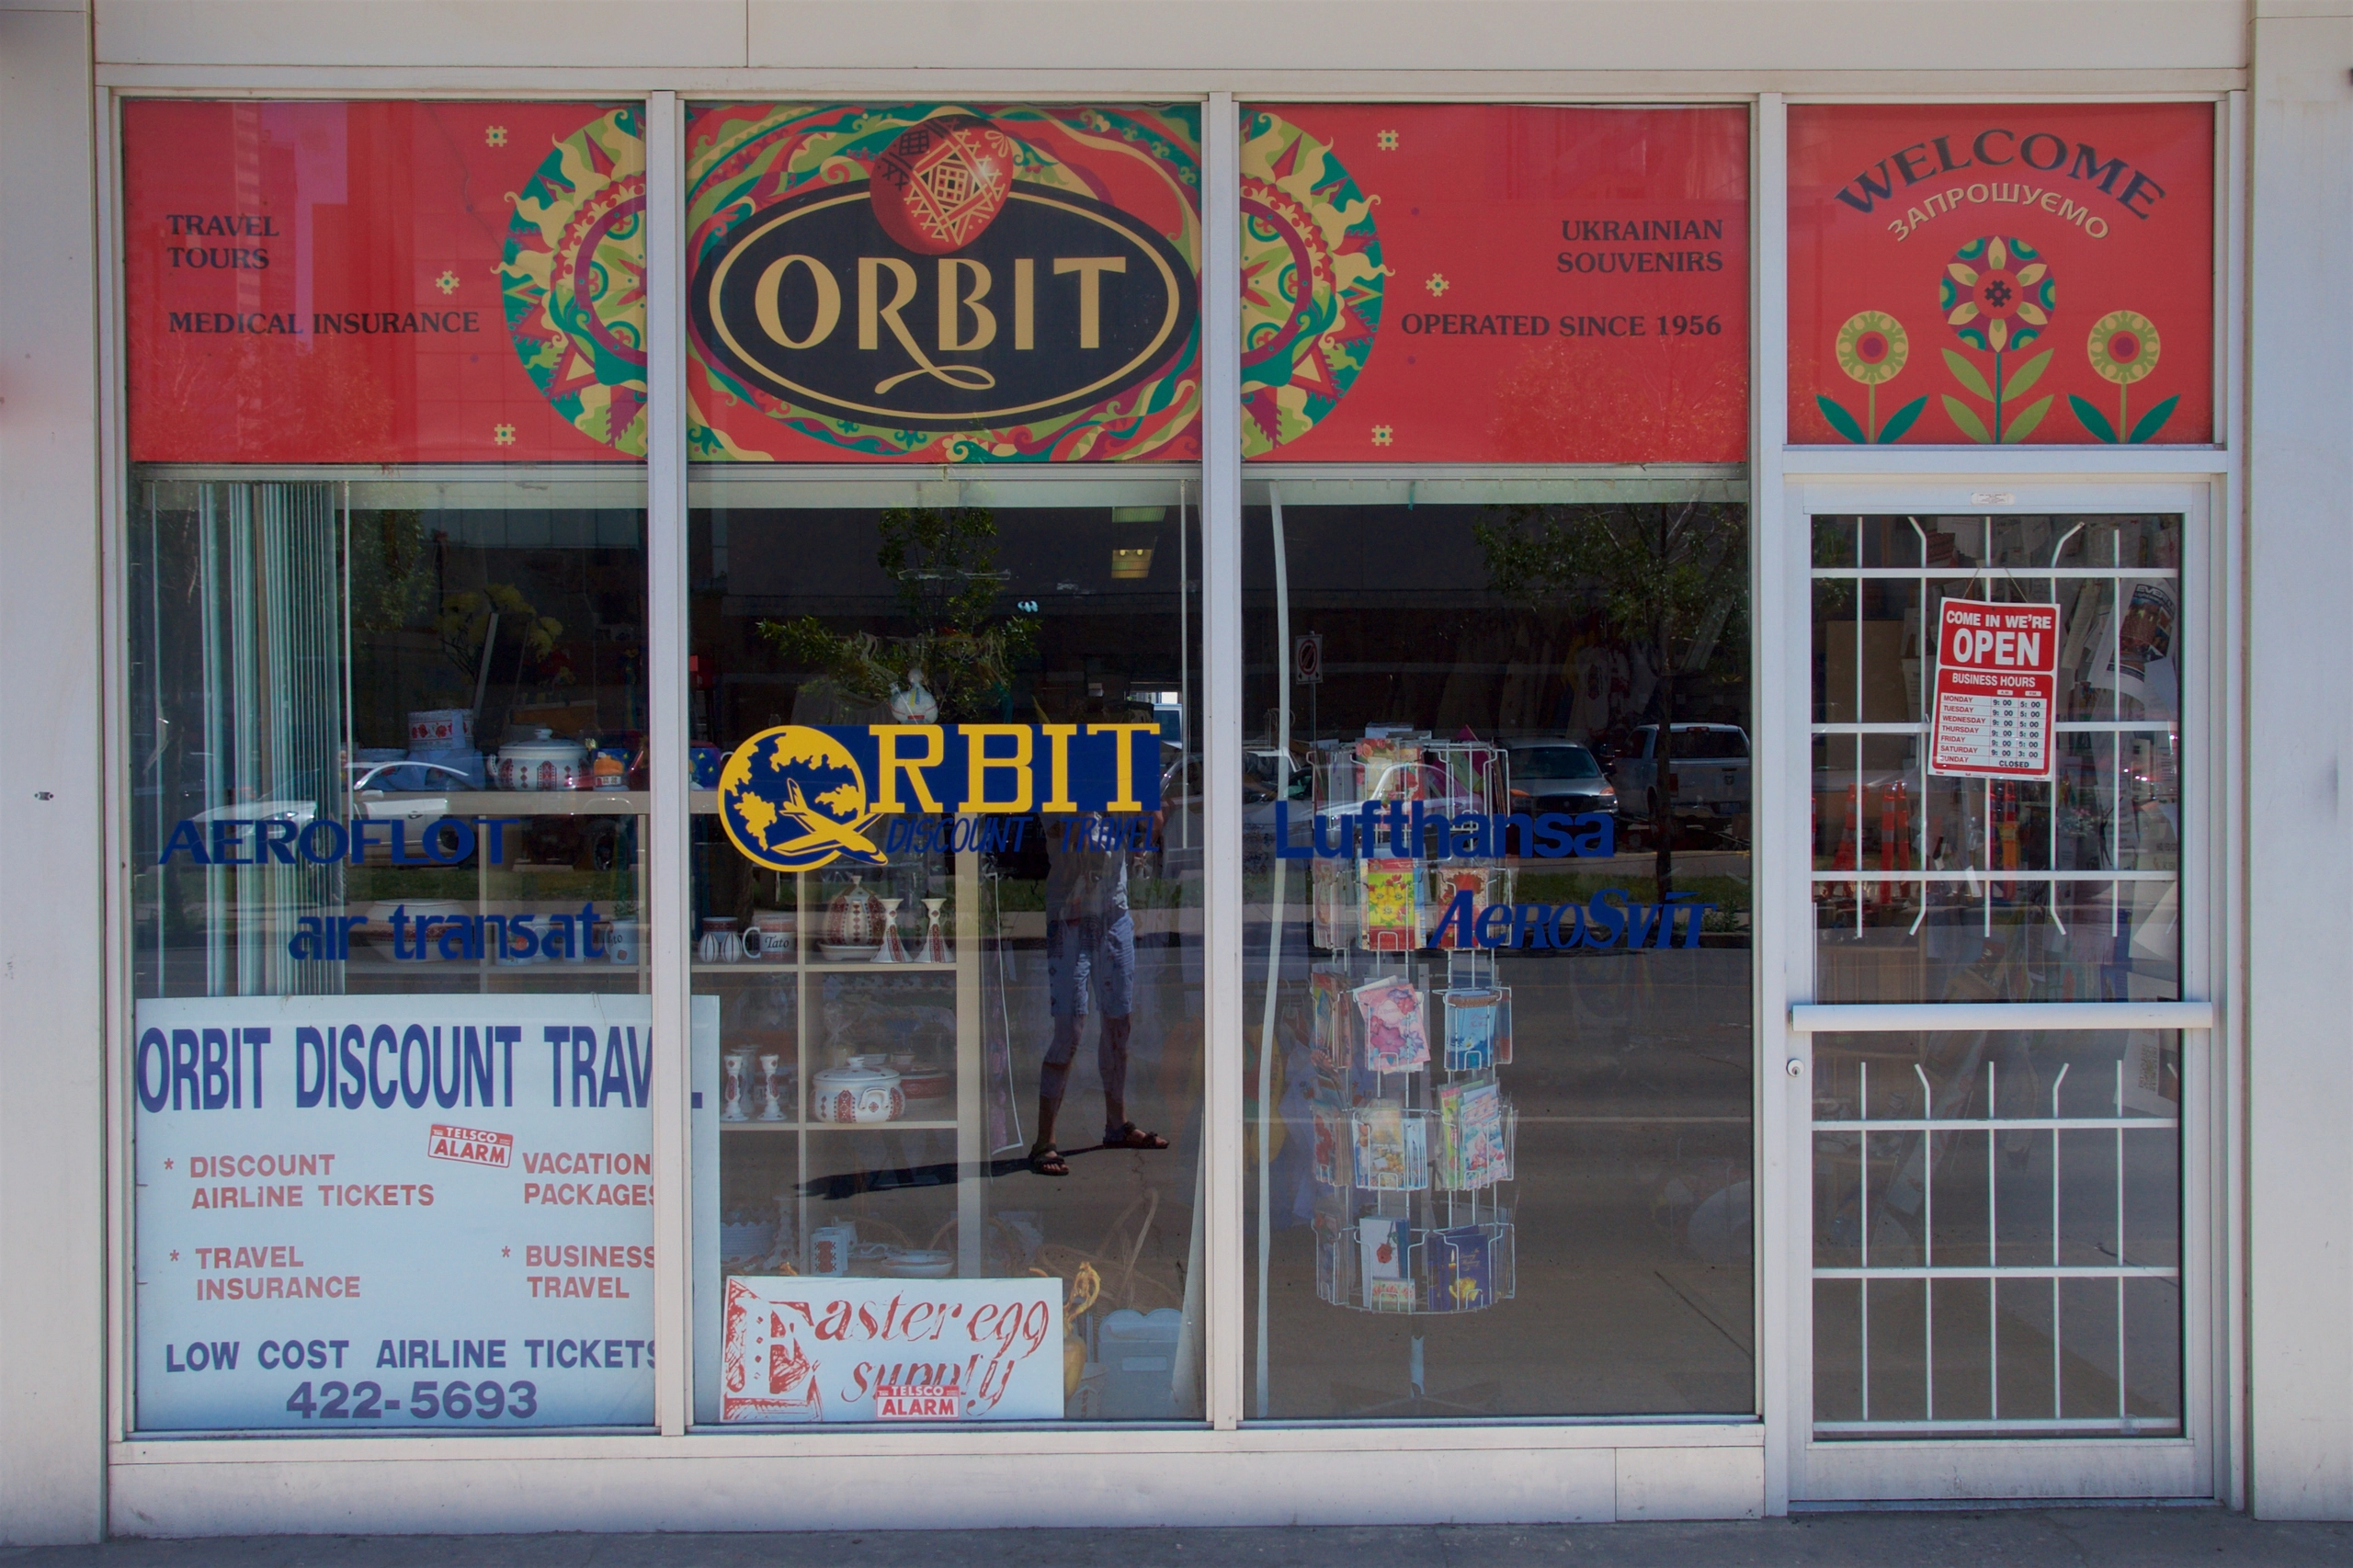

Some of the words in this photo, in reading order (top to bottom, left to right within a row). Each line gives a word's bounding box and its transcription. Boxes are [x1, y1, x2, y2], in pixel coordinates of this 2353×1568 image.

[1833, 128, 2166, 221] WELCOME
[1887, 182, 2110, 242] ЗАПРОШУЄМО
[166, 213, 279, 237] TRAVEL
[1562, 219, 1724, 243] UKRAINIAN
[166, 246, 269, 269] TOURS
[1556, 251, 1724, 274] SOUVENIRS
[167, 311, 303, 335] MEDICAL
[313, 311, 481, 335] INSURANCE
[755, 254, 1126, 394] ORBIT
[1401, 312, 1551, 336] OPERATED
[1559, 314, 1647, 336] SINCE
[1656, 314, 1723, 336] 1956
[1946, 610, 1982, 627] COME
[1985, 614, 2000, 628] IN
[2005, 614, 2052, 630] WE'RE
[1952, 628, 2040, 667] OPEN
[1951, 673, 1997, 687] BUSINESS
[1999, 676, 2036, 688] HOURS
[1943, 695, 1972, 703] MONDAY
[1943, 705, 1973, 713] TUESDAY
[1942, 715, 1986, 724] WEDNESDAY
[1942, 725, 1979, 733] THURSDAY
[1940, 745, 1978, 754] SATURDAY
[1940, 755, 1969, 763] SUNDAY
[1998, 760, 2029, 768] CLOSED
[886, 816, 1036, 853] DISCOUNT
[1060, 815, 1160, 852] TRAVEL
[1275, 800, 1615, 858] Lufthansa
[158, 818, 520, 865] AEROFLOT
[288, 914, 369, 960] air
[388, 902, 604, 960] transat
[764, 935, 790, 949] Tato
[137, 1027, 272, 1114] ORBIT
[296, 1023, 522, 1108] DISCOUNT
[544, 1026, 703, 1109] TRAV
[446, 1127, 497, 1143] TELSCO
[433, 1138, 505, 1165] ALARM
[522, 1152, 651, 1175] VACATION
[190, 1153, 335, 1177] DISCOUNT
[191, 1187, 304, 1210] AIRLINE
[318, 1184, 435, 1207] TICKETS
[195, 1245, 305, 1269] TRAVEL
[526, 1244, 654, 1268] BUSINESS
[197, 1276, 361, 1301] INSURANCE
[526, 1276, 631, 1299] TRAVEL
[165, 1340, 240, 1372] LOW
[256, 1339, 349, 1369] COST
[376, 1339, 506, 1369] AIRLINE
[722, 1278, 963, 1422] Easter
[966, 1298, 1050, 1360] egg
[286, 1380, 539, 1420] 422-5693
[892, 1385, 944, 1397] TELSCO
[881, 1398, 954, 1415] ALARM
